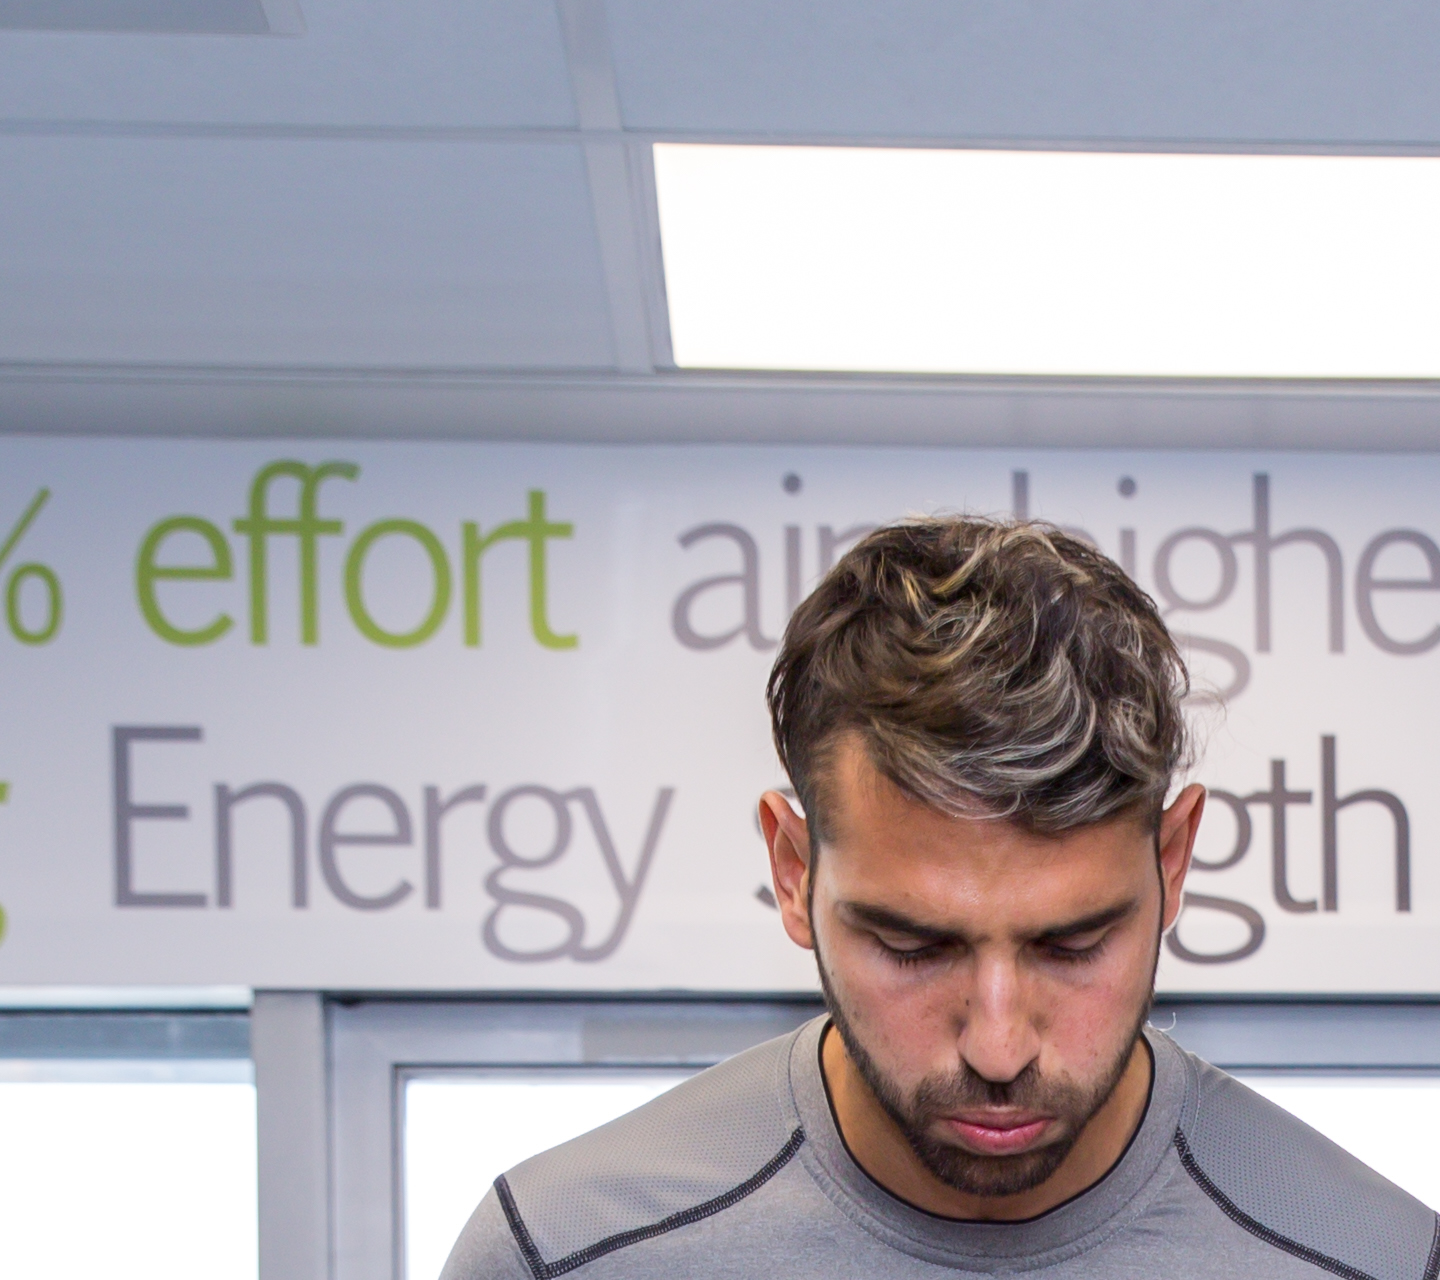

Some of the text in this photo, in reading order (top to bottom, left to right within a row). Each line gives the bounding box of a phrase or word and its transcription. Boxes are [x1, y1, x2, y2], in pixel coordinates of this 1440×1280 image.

[136, 459, 579, 651] effort
[670, 472, 872, 652] ai
[110, 723, 675, 963] Energy
